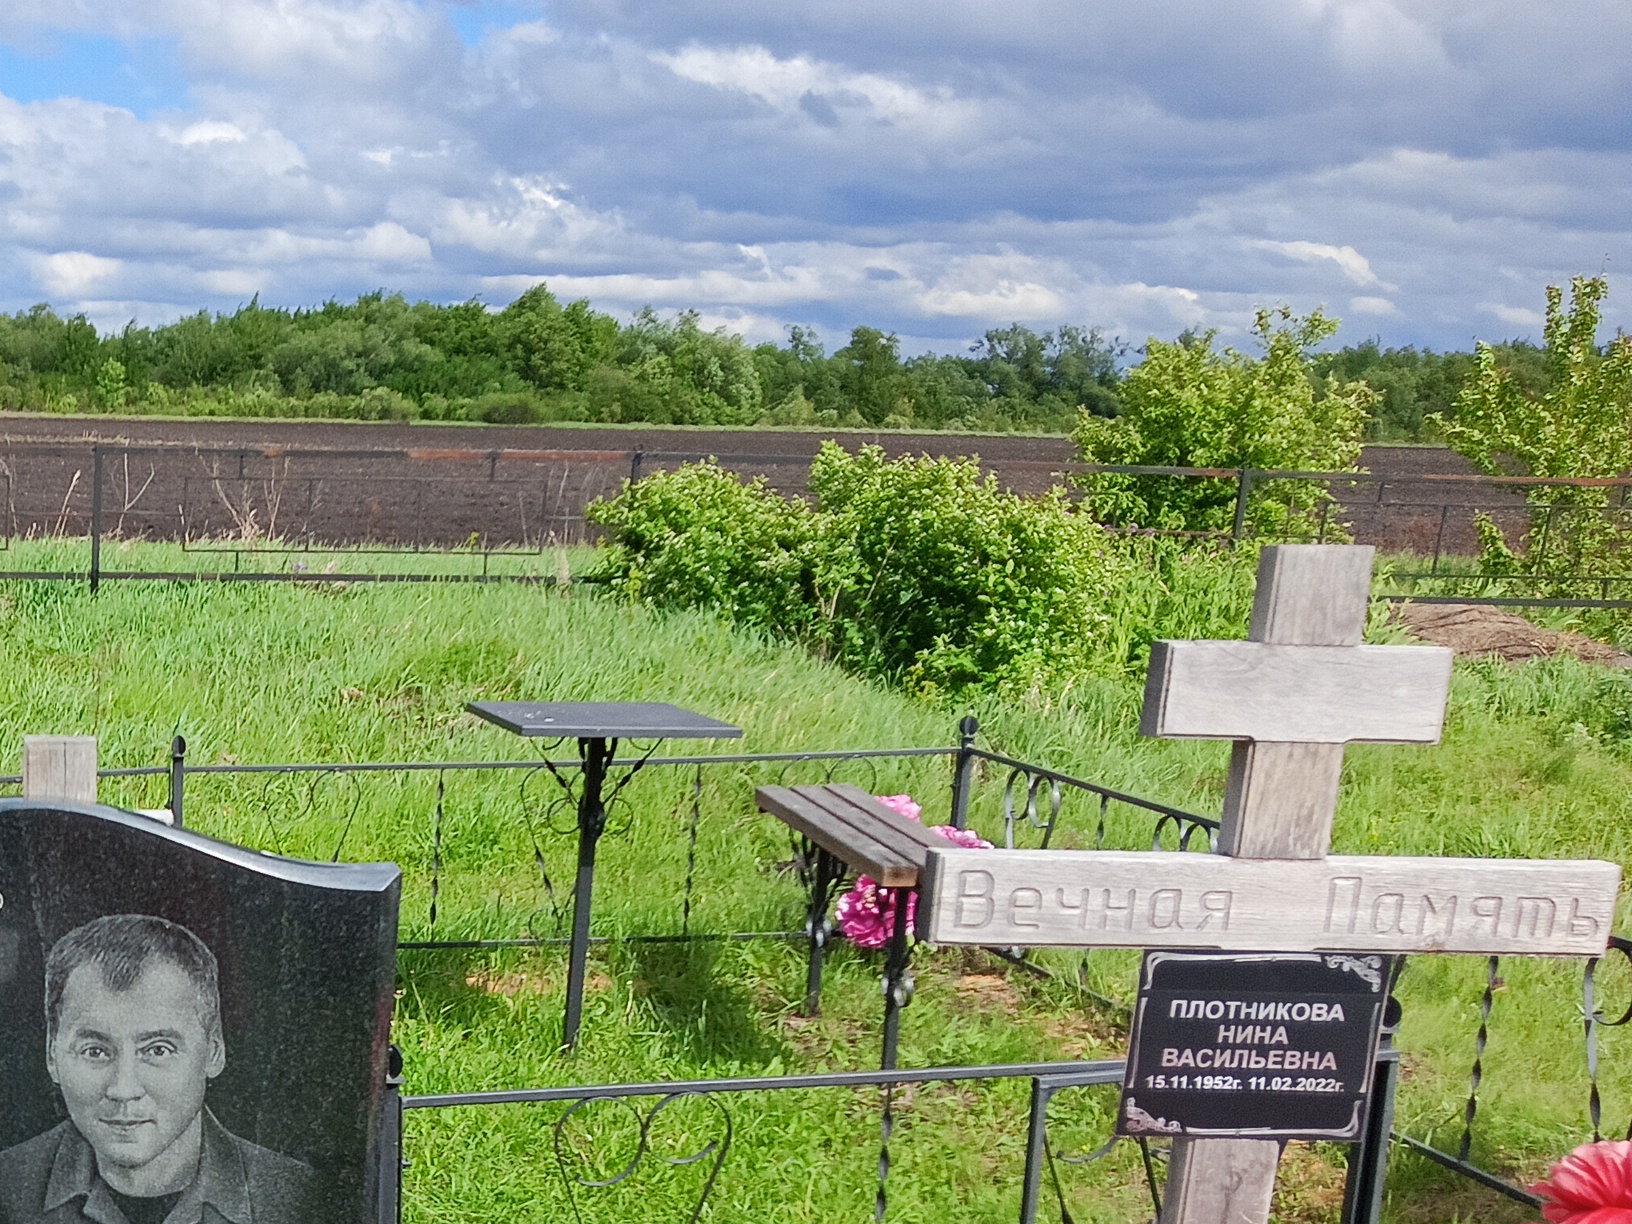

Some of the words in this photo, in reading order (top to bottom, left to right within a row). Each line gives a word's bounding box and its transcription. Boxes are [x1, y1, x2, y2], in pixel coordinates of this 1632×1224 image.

[953, 869, 1233, 931] Вечная
[1323, 876, 1599, 939] Память
[1169, 1000, 1345, 1022] ПЛОТНИКОВА
[1217, 1025, 1289, 1045] НИНА
[1161, 1048, 1338, 1071] ВАСИЛЬЕВНА
[1145, 1075, 1243, 1090] 15.11.1952г.
[1248, 1076, 1345, 1093] 11.02.2022г.
